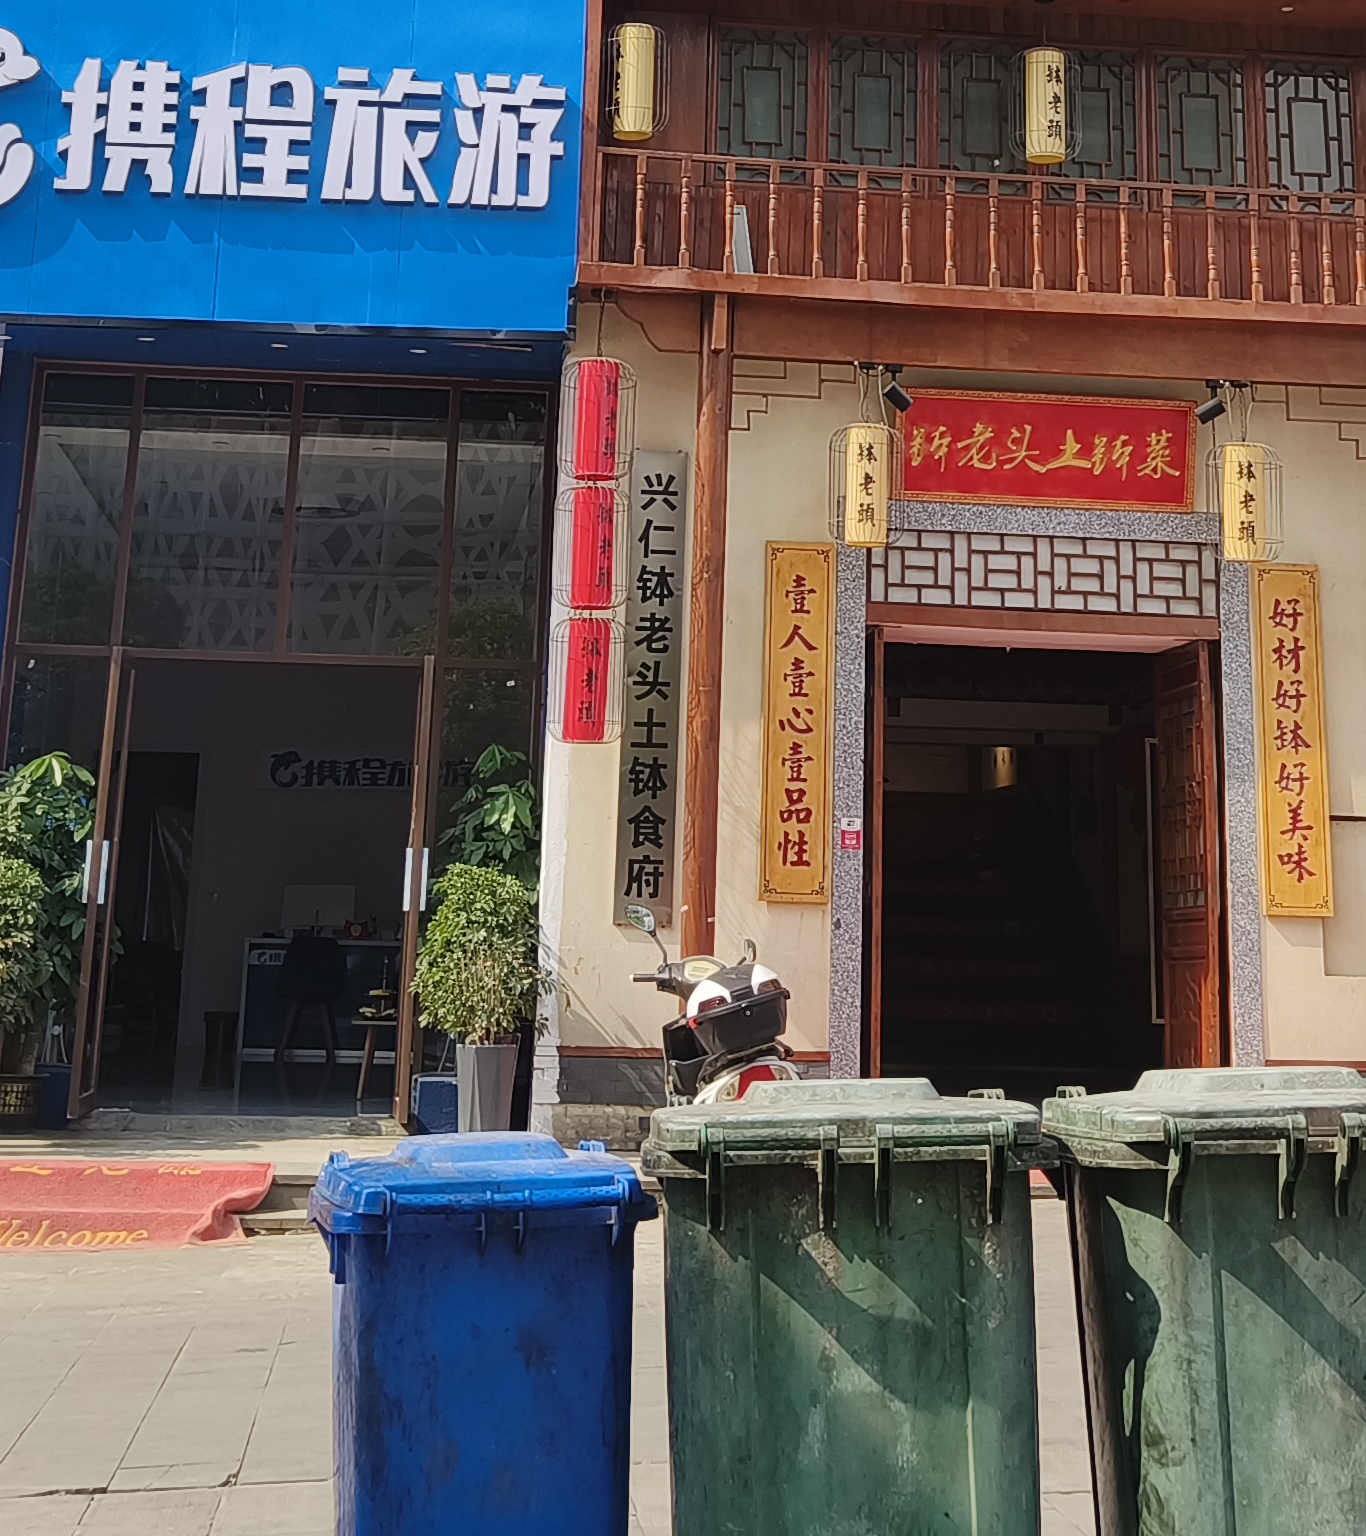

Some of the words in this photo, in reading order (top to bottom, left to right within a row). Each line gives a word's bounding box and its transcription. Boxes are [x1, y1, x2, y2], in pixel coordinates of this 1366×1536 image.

[53, 56, 567, 212] 携程旅游
[623, 472, 680, 901] 兴仁钵老头土钵食府
